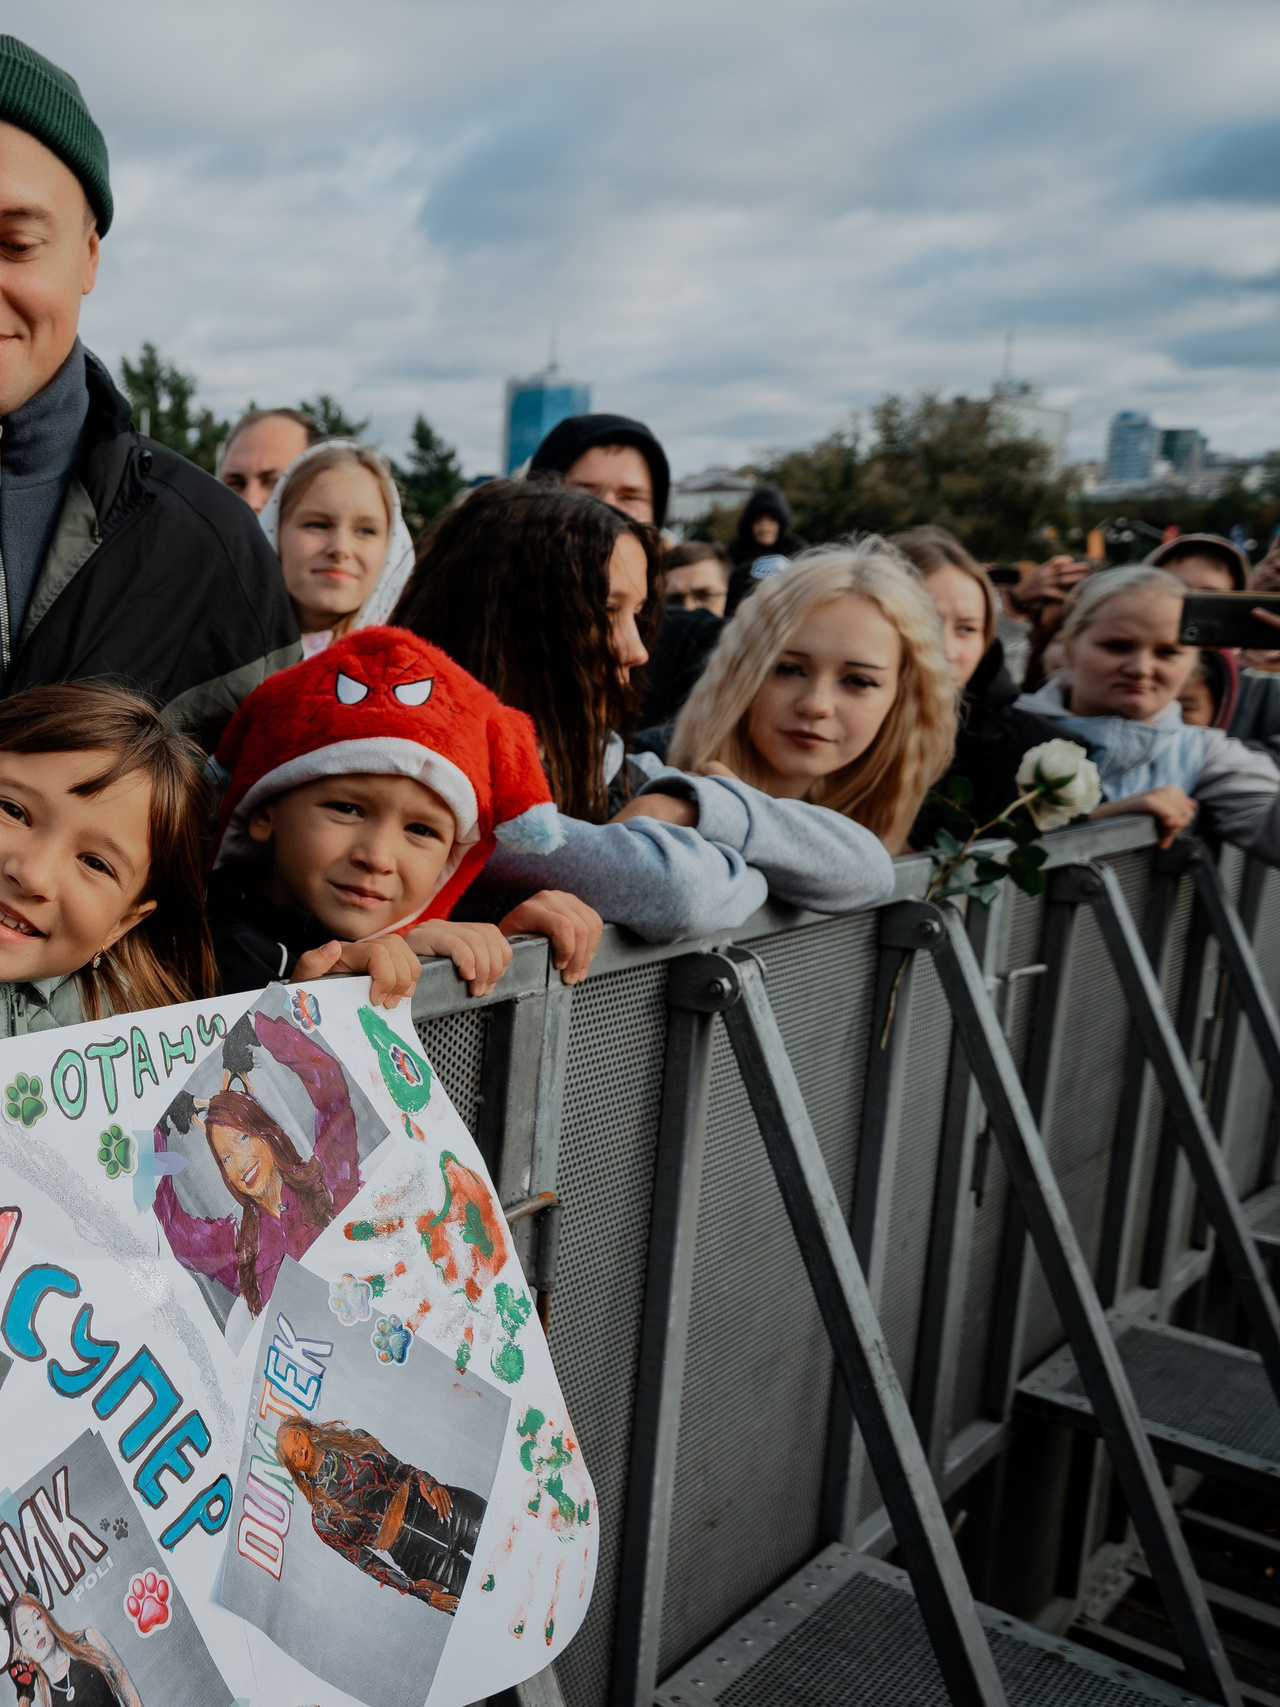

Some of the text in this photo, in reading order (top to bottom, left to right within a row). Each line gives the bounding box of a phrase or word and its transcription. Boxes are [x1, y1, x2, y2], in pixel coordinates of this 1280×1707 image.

[0, 1263, 233, 1552] СУПЕР
[246, 1394, 258, 1444] POLI
[71, 1555, 115, 1603] POLI
